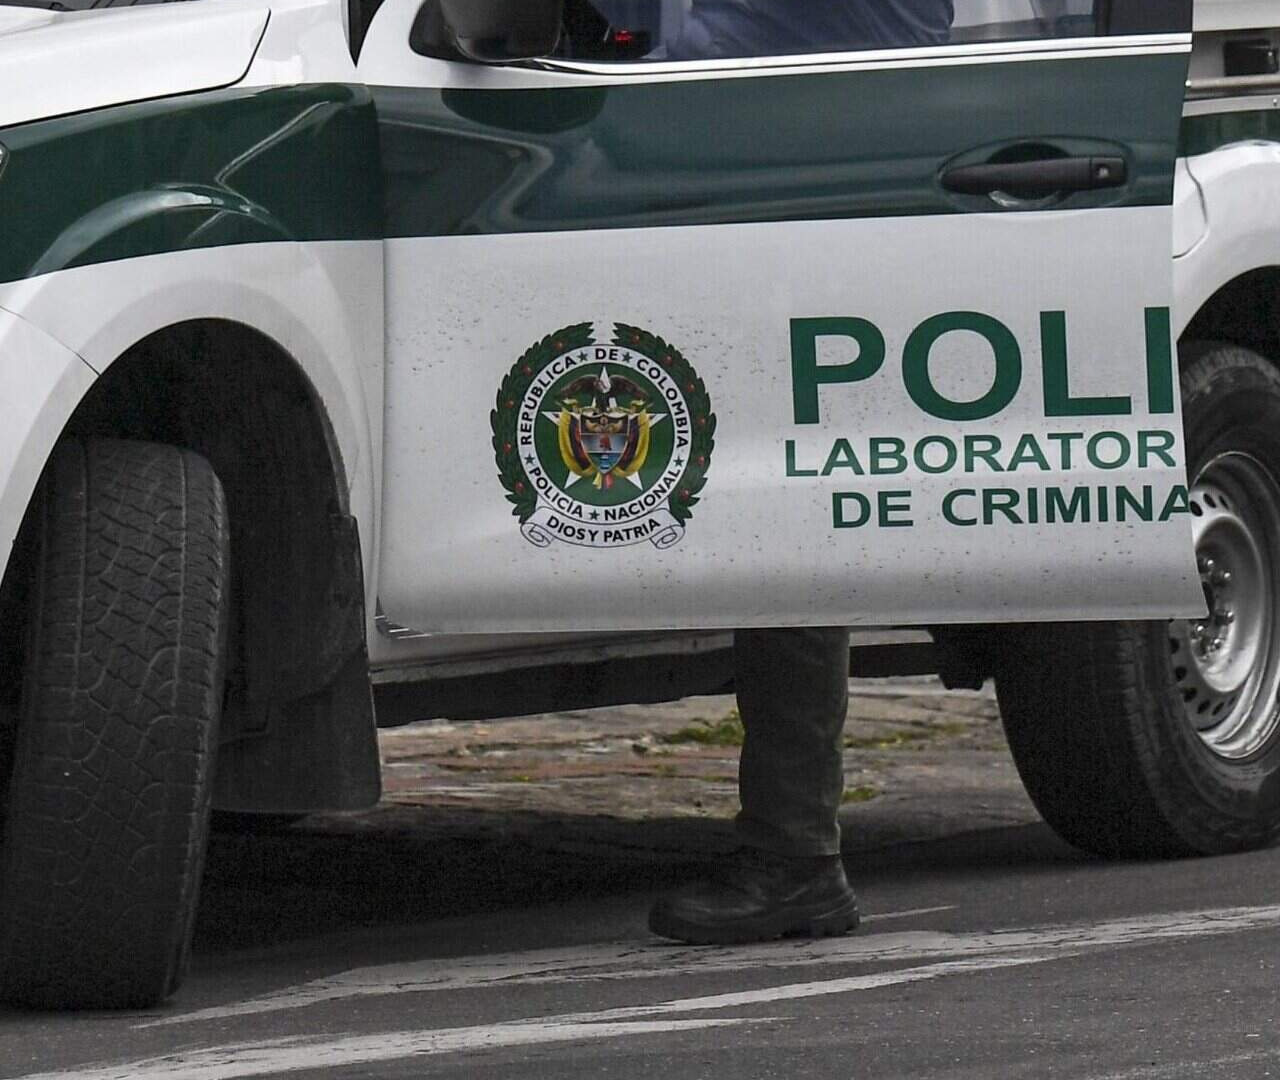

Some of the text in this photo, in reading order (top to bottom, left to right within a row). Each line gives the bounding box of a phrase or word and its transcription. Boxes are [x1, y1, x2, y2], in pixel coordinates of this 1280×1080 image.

[789, 306, 1175, 424] POLI
[595, 348, 619, 360] DE
[636, 358, 689, 448] COLOMBIA
[785, 430, 1177, 477] LABORATOR
[604, 469, 682, 521] NACIONAL
[832, 484, 1190, 529] DE CRIMINA
[546, 515, 661, 543] DIOS Y PATRIA
